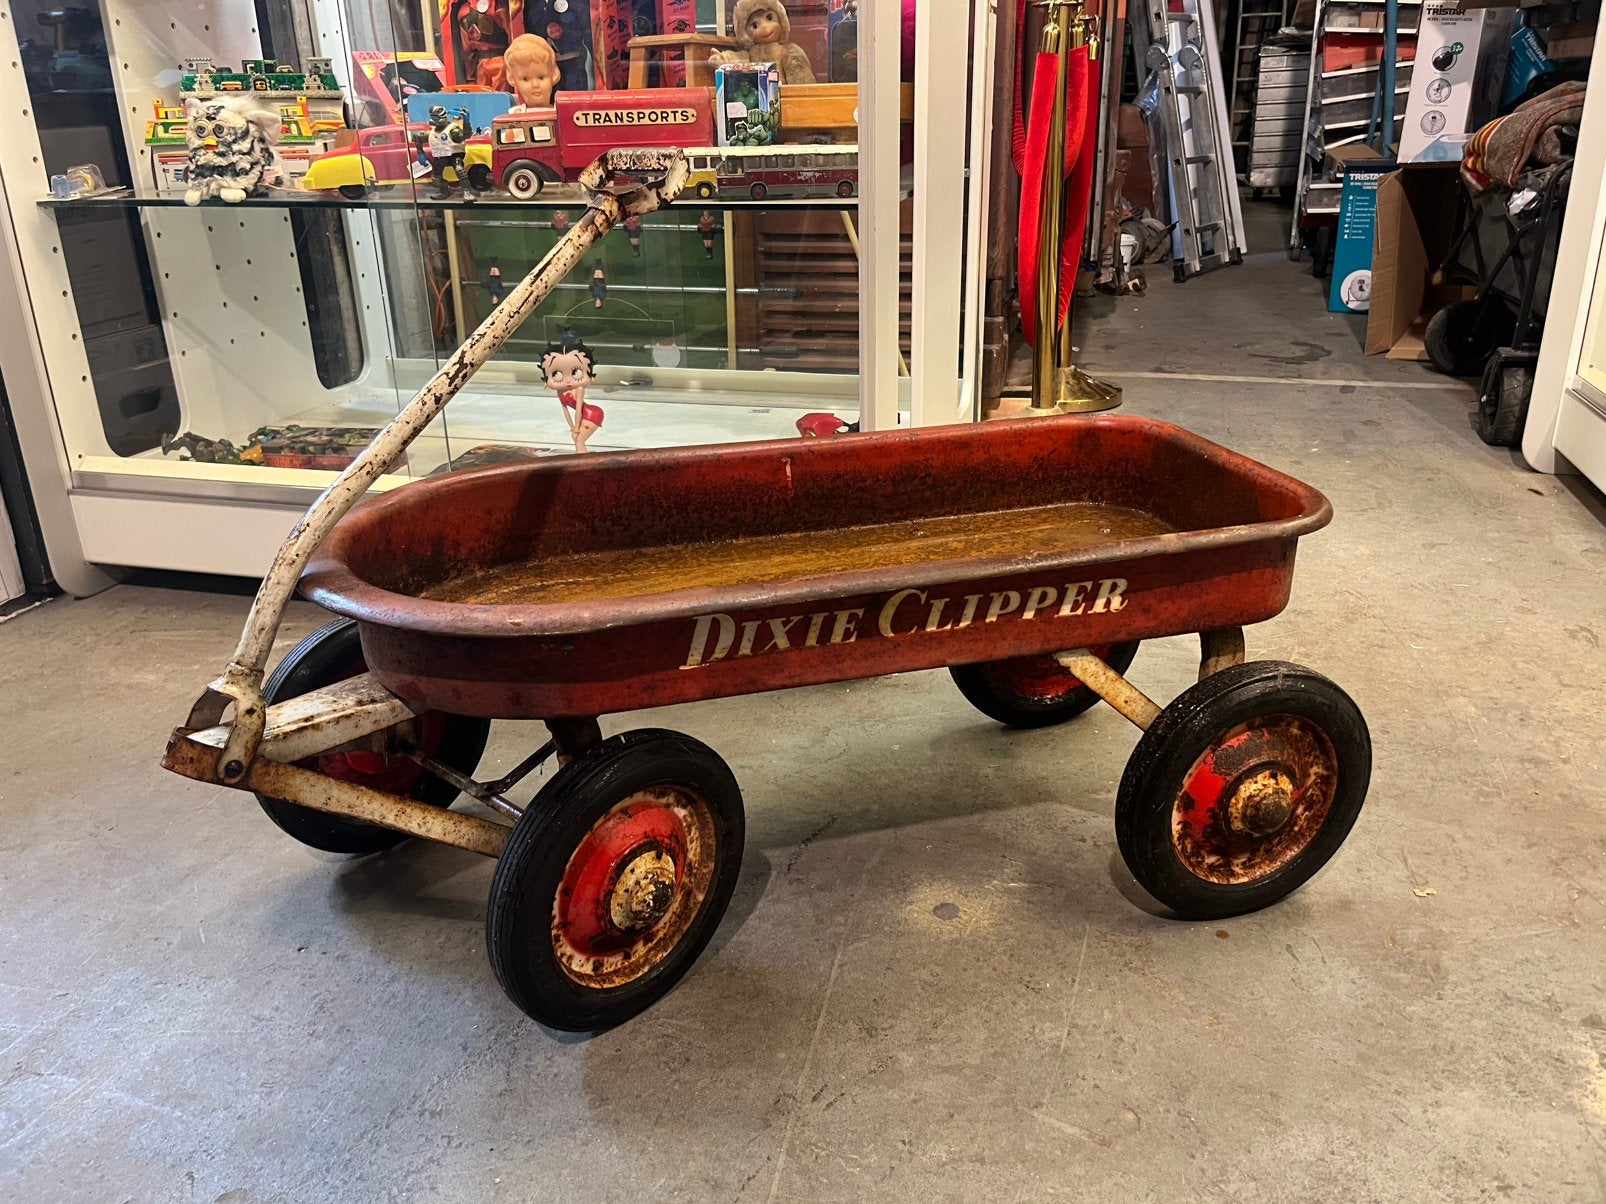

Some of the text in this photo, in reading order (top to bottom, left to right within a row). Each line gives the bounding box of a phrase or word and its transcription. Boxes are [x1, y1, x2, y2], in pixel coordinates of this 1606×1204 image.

[582, 110, 689, 124] TRANSPORTS
[1349, 173, 1385, 181] TRISTA
[679, 578, 1128, 669] DIXIE CLIPPER
